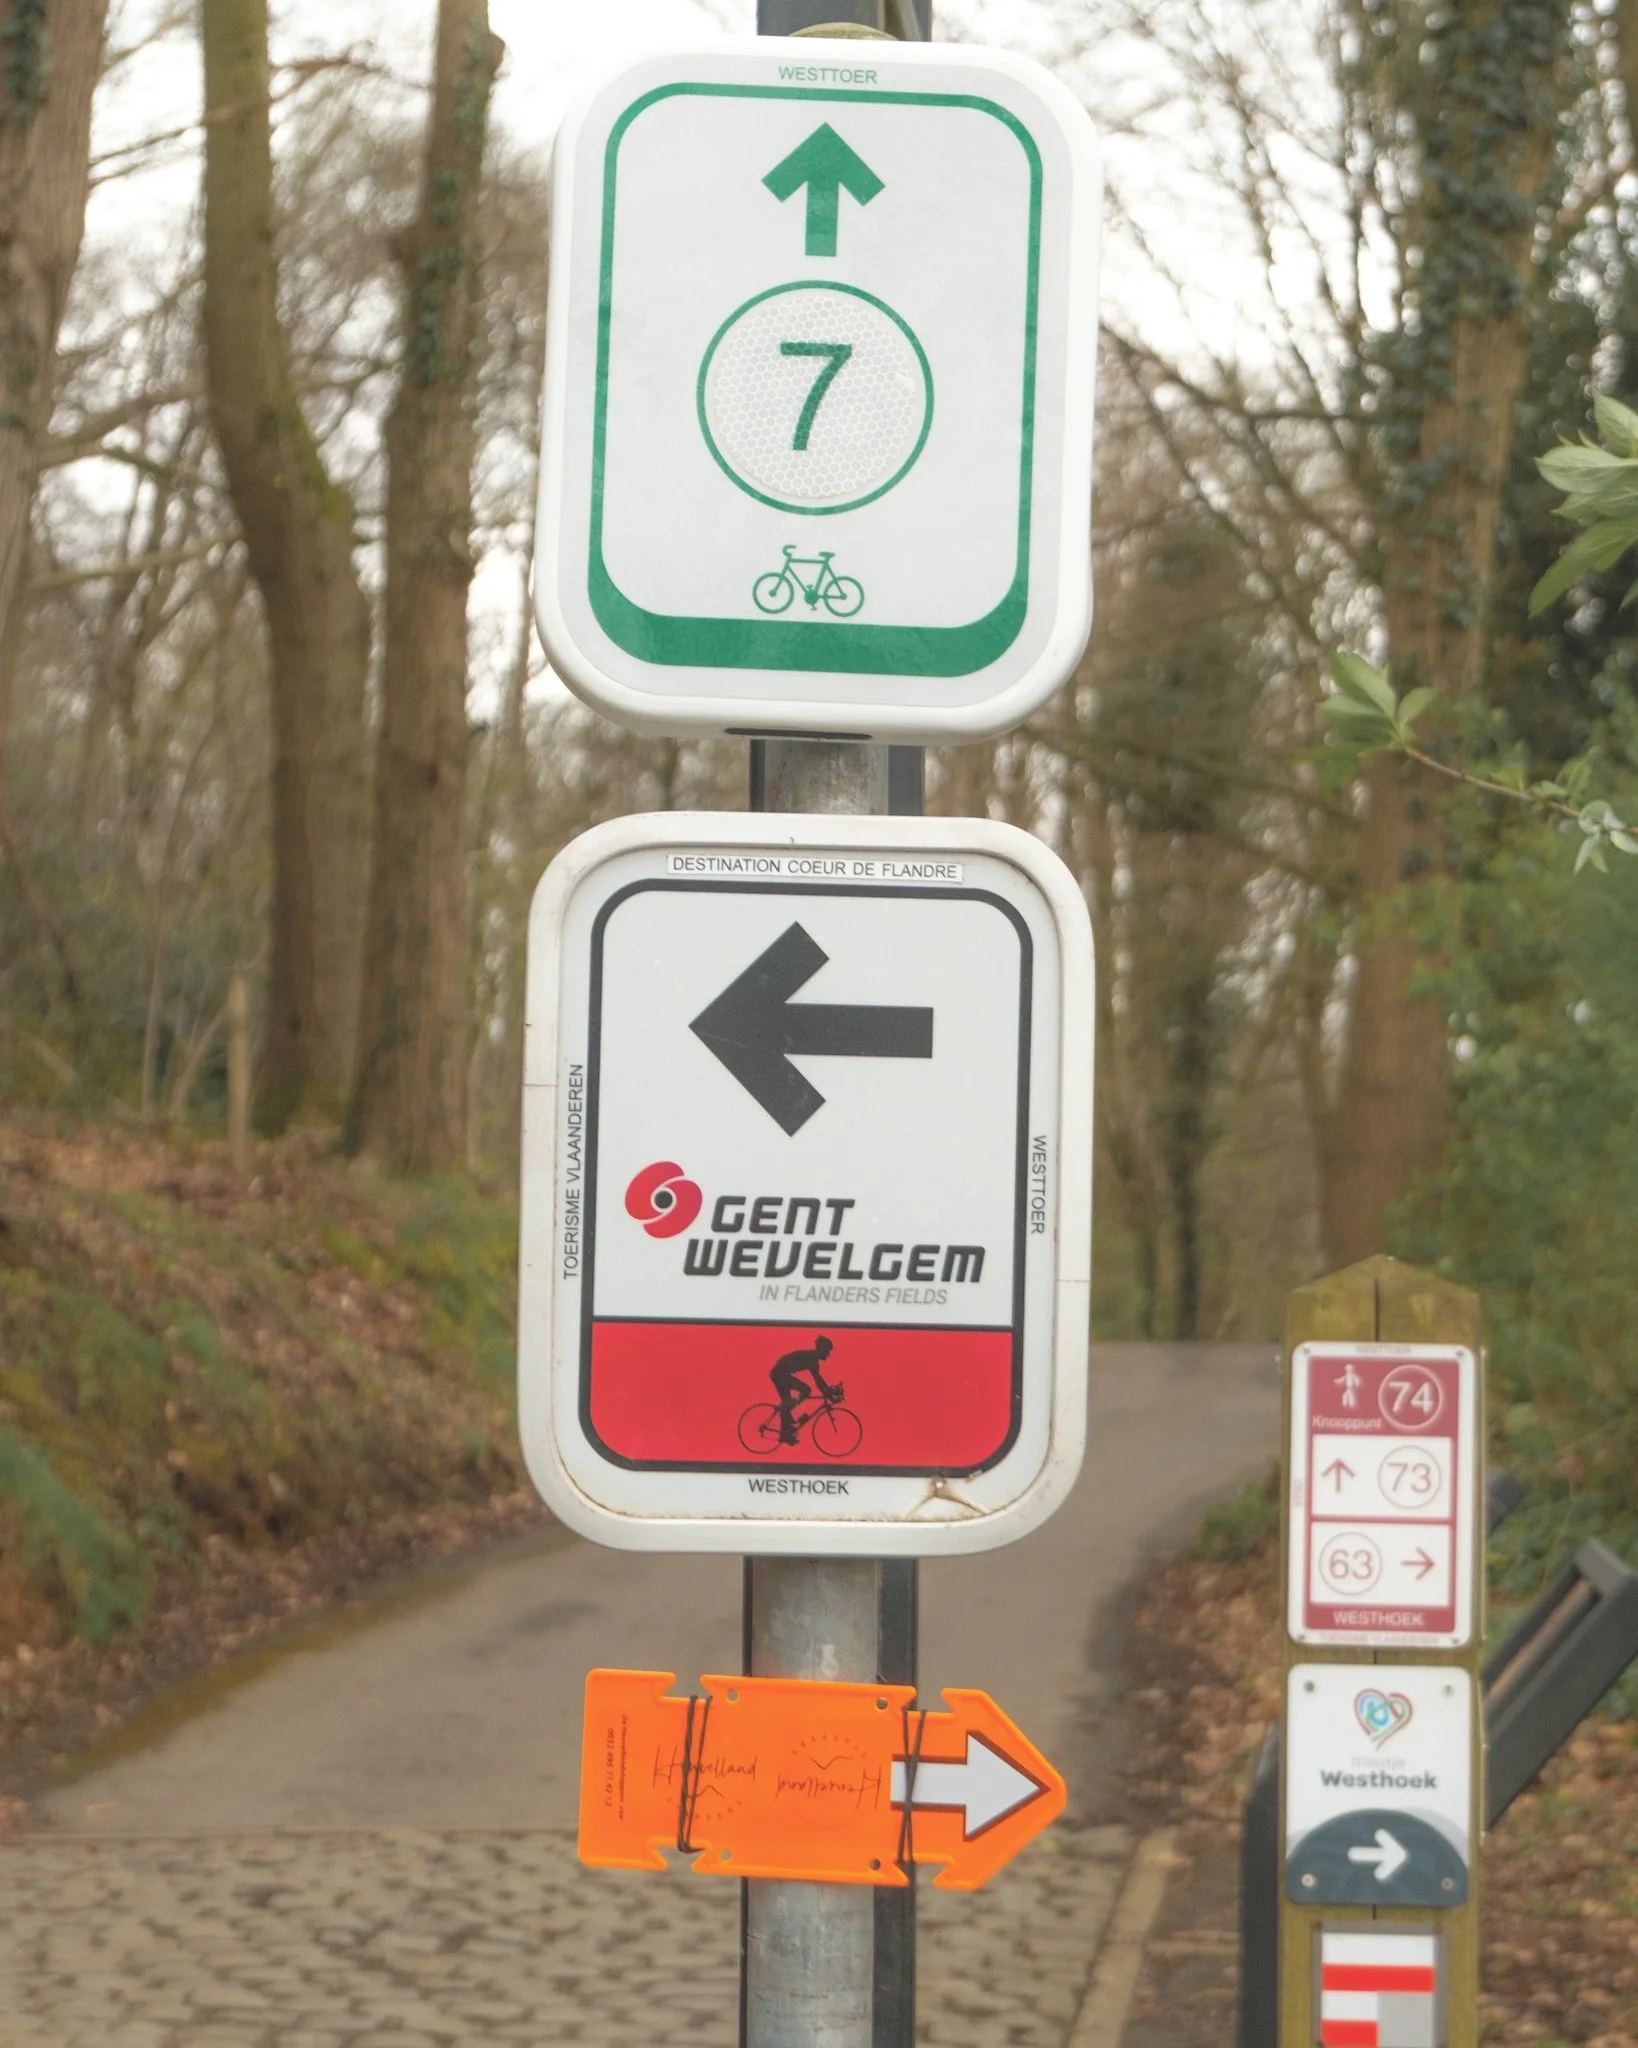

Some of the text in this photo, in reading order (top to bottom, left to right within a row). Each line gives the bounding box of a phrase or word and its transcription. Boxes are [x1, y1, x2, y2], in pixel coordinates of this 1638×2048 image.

[777, 65, 878, 84] WESTTOER
[779, 341, 854, 452] 7
[672, 857, 958, 879] DESTINATION COEUR DE FLANDRE
[563, 1063, 583, 1281] TOERISME VLAANDEREN
[1030, 1134, 1048, 1236] WESTTOER
[711, 1194, 856, 1236] GENT
[682, 1238, 986, 1283] WEVELGEM
[759, 1284, 949, 1306] IN FLANDERS FIELDS
[1387, 1380, 1434, 1414] 74
[1311, 1415, 1382, 1430] Knooppunt
[748, 1478, 850, 1495] WESTHOEK
[1387, 1461, 1432, 1494] 73
[1328, 1548, 1374, 1581] 63
[1332, 1610, 1424, 1627] WESTHOEK
[1318, 1767, 1439, 1790] Westhoek
